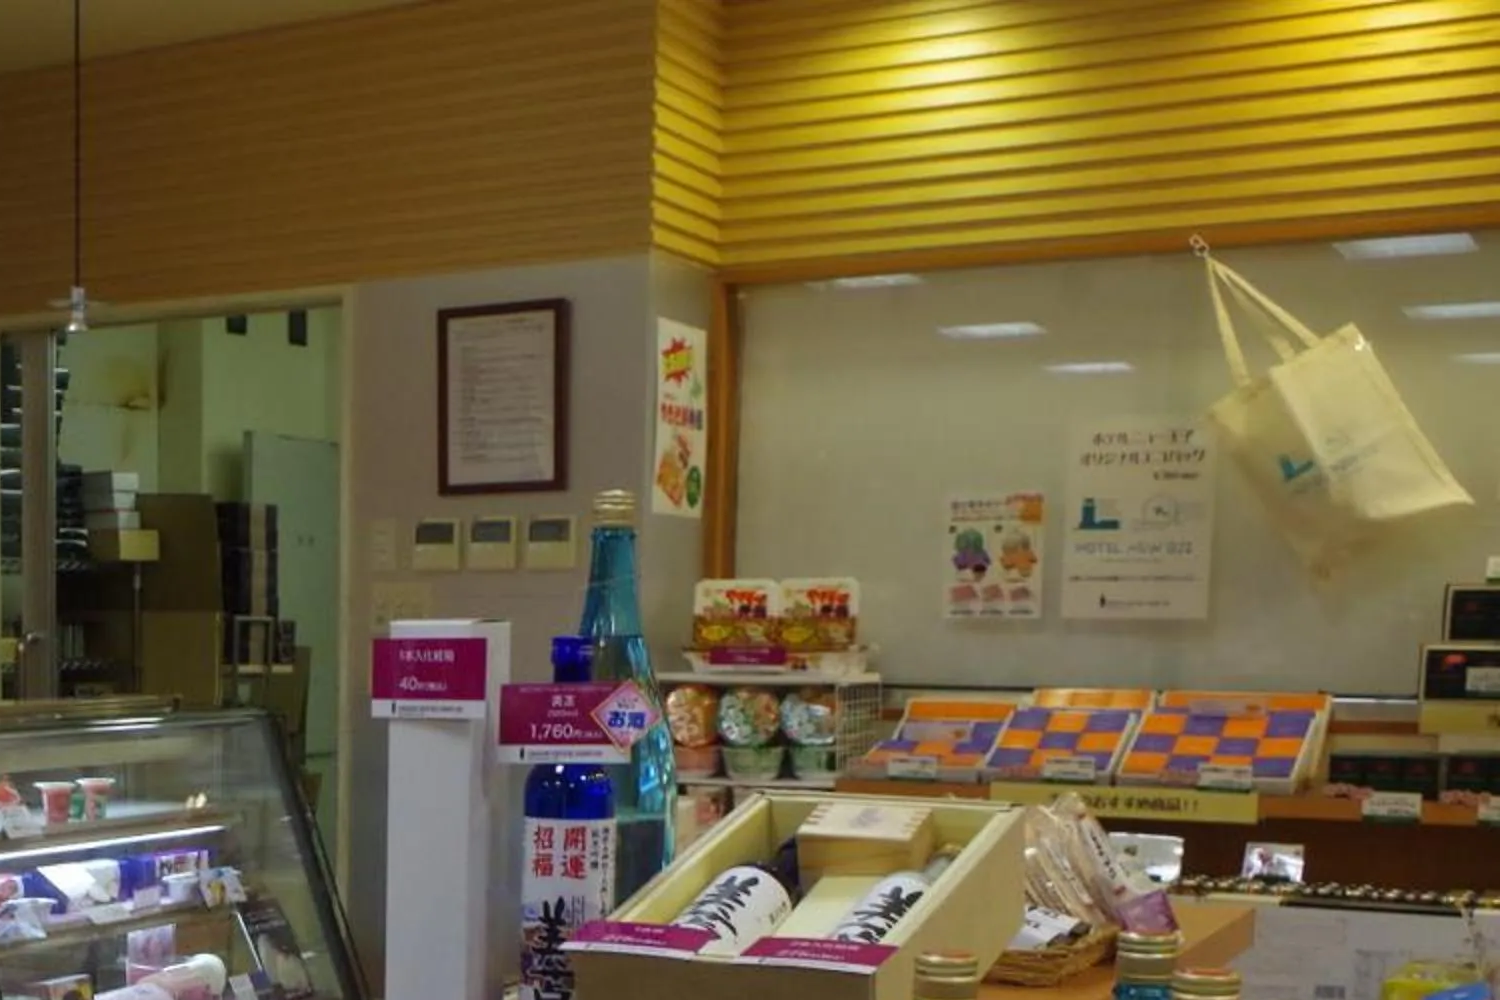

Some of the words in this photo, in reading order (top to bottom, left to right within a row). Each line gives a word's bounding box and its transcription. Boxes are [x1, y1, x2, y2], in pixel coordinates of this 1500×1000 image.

[607, 711, 647, 729] お酒
[533, 825, 555, 879] 招福
[561, 825, 588, 880] 開運
